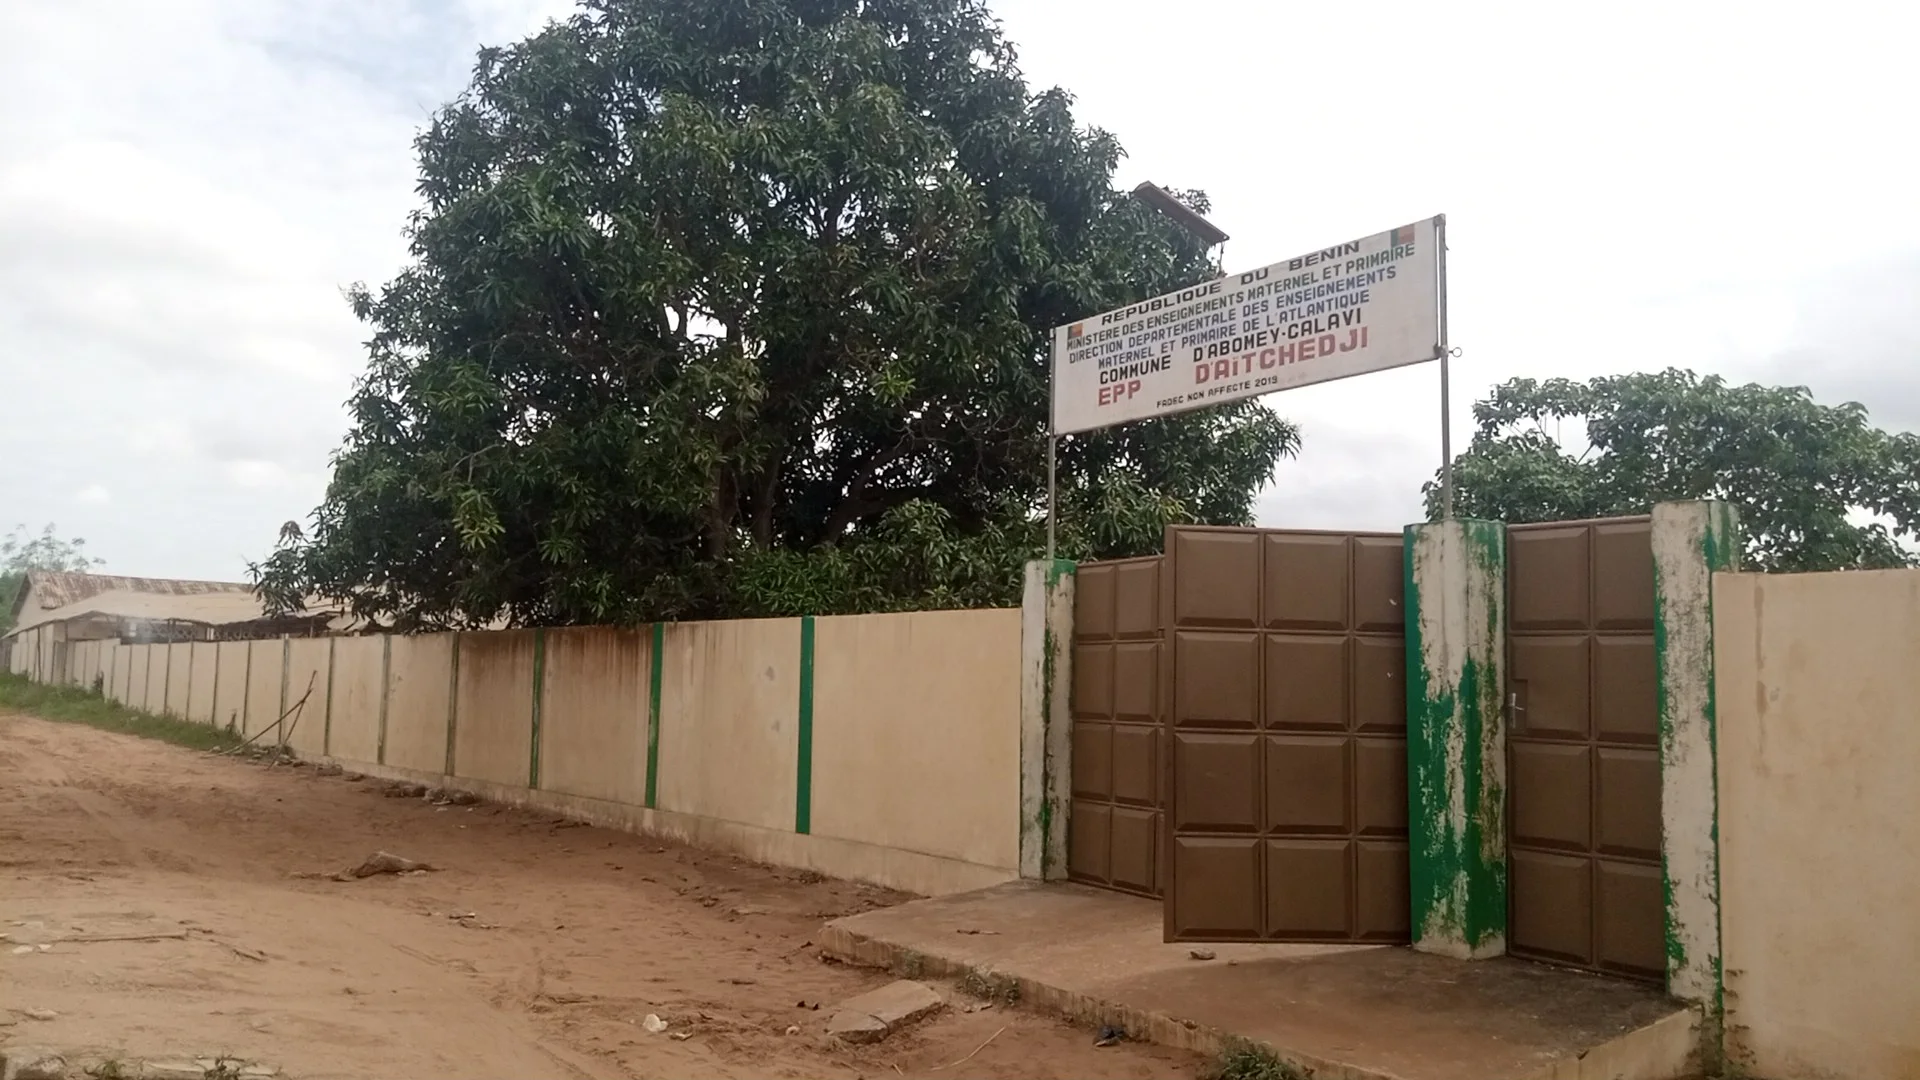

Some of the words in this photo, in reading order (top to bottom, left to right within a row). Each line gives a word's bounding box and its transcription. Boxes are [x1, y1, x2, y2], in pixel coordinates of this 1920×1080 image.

[1067, 326, 1120, 351] MINISTERE
[1122, 320, 1144, 336] DES
[1147, 291, 1244, 329] ENSEIGNEMENTS
[1248, 272, 1319, 301] MATERNEL
[1323, 264, 1341, 280] ET
[1346, 243, 1415, 274] PRIMAIRE
[1069, 340, 1123, 364] DIRECTION
[1129, 308, 1236, 348] DEPARTEMENTALE
[1243, 300, 1268, 317] DES
[1277, 265, 1396, 309] ENSEIGNEMENTS
[1101, 282, 1221, 326] REPUBLIQUE
[1241, 268, 1268, 285] DU
[1288, 241, 1360, 271] BENIN
[1098, 347, 1154, 370] MATERNEL
[1161, 340, 1176, 354] ET
[1182, 323, 1236, 349] PRIMAIRE
[1243, 318, 1259, 333] DE
[1267, 289, 1370, 327] L'ATLANTIQUE
[1100, 355, 1171, 385] COMMUNE
[1098, 380, 1141, 407] EPP
[1157, 396, 1183, 408] FADEC
[1187, 391, 1204, 402] NON
[1208, 380, 1250, 397] AFFECTE
